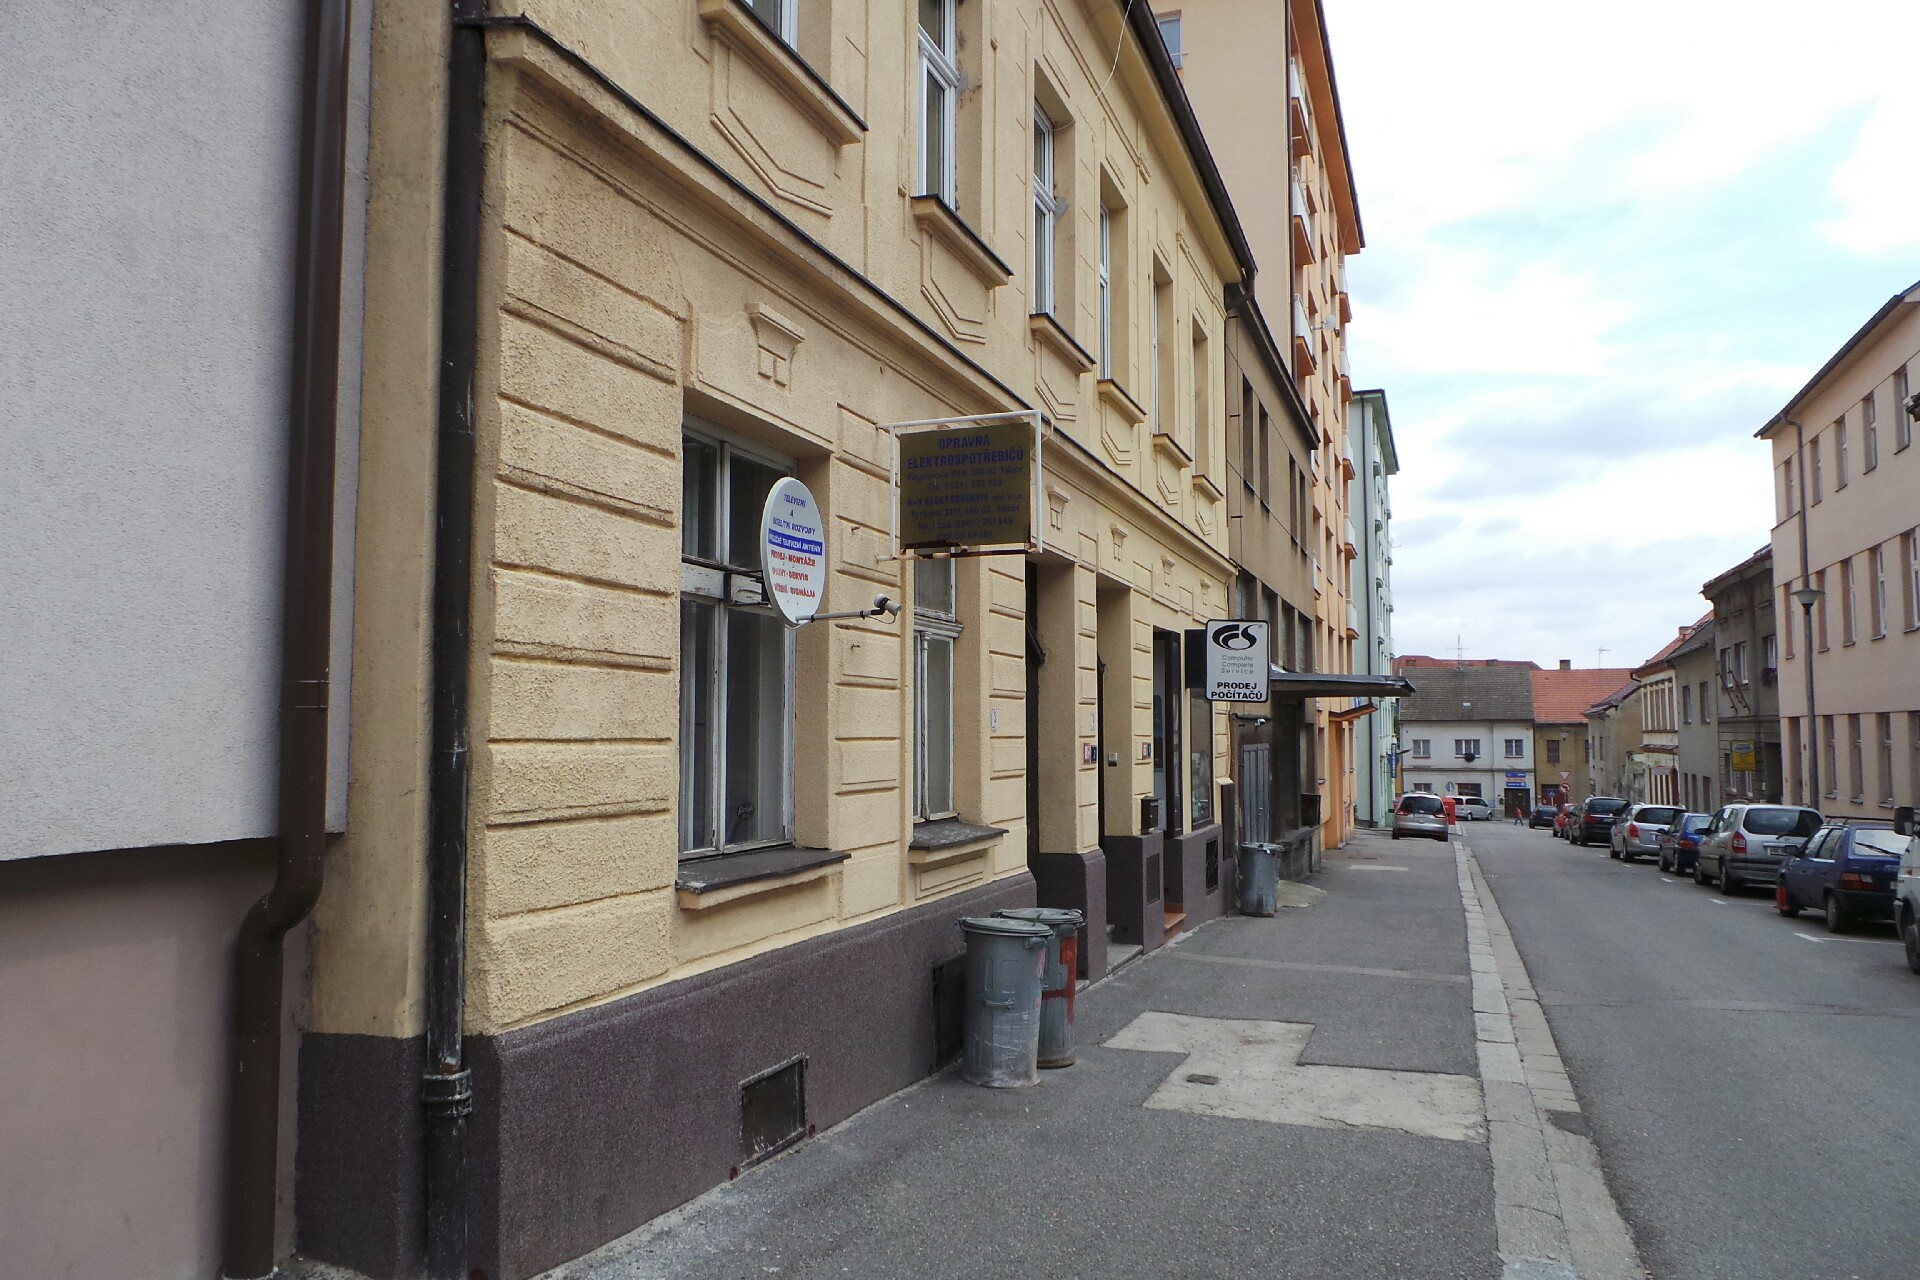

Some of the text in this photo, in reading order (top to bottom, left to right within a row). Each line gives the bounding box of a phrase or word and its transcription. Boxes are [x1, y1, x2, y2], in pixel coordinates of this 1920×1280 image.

[939, 435, 990, 449] OPRAVNA
[907, 446, 1024, 469] ELEKTROSPOTŘEBIČŮ
[783, 493, 806, 508] TELEVIZNÍ
[925, 493, 989, 505] ELEKTROSERVIS
[789, 509, 794, 517] A
[791, 523, 816, 535] ROZVODY
[802, 543, 822, 553] ANTÉNY
[788, 554, 816, 567] MONTÁŽE
[789, 570, 809, 581] SERVIS
[1221, 654, 1254, 662] Computer
[1216, 681, 1257, 690] PRODEJ
[1211, 689, 1263, 700] POČÍTAČŮ
